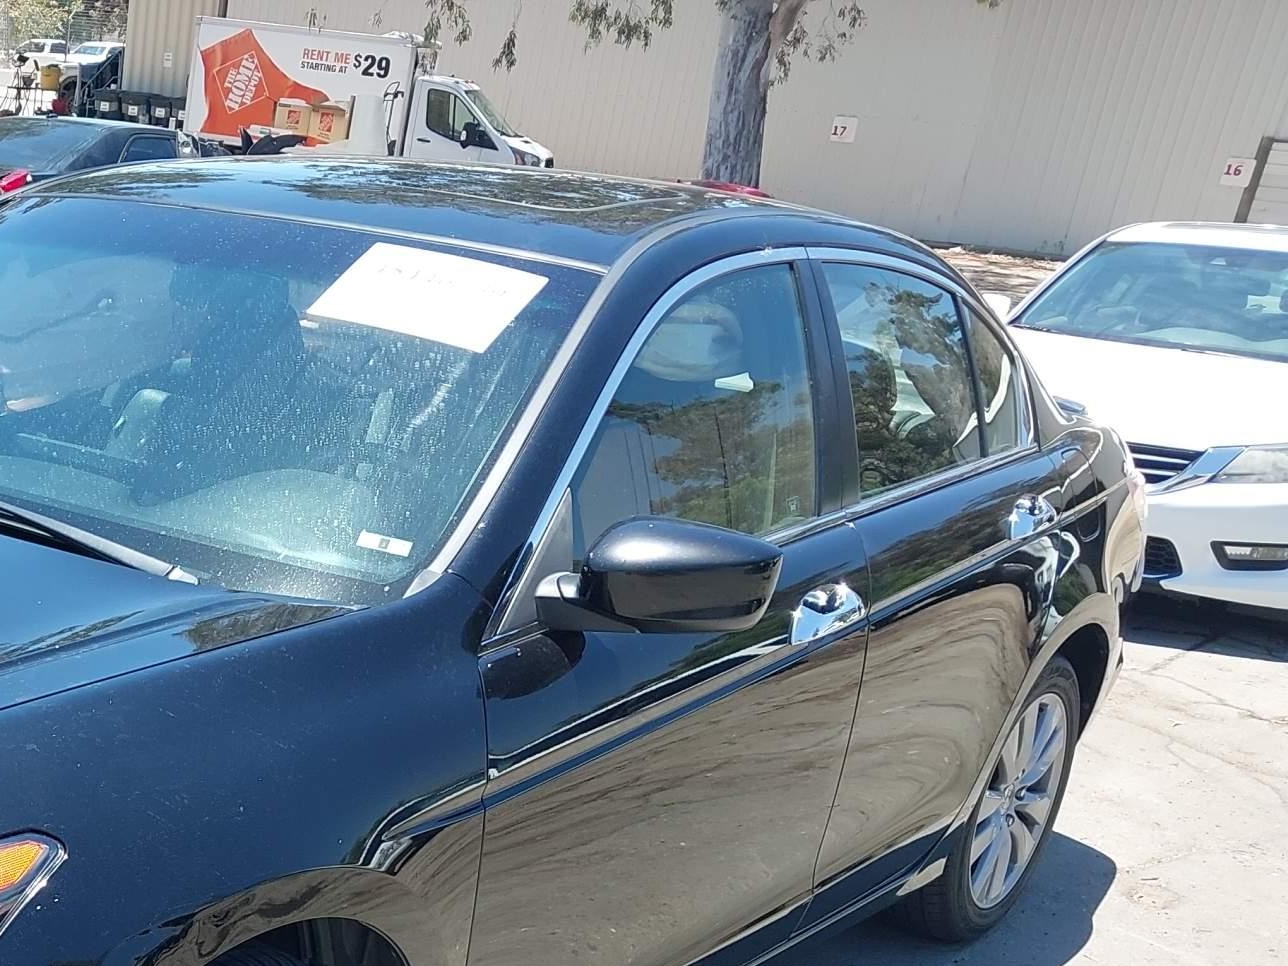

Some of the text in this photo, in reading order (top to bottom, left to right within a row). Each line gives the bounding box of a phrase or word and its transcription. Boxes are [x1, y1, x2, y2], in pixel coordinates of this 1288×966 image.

[302, 48, 351, 64] RENT ME
[301, 61, 348, 74] STARTING AT
[353, 53, 391, 78] $29
[224, 67, 238, 88] THE
[226, 54, 256, 110] HOME
[242, 69, 261, 104] DEPOT
[832, 125, 848, 137] 17
[1223, 164, 1244, 176] 16
